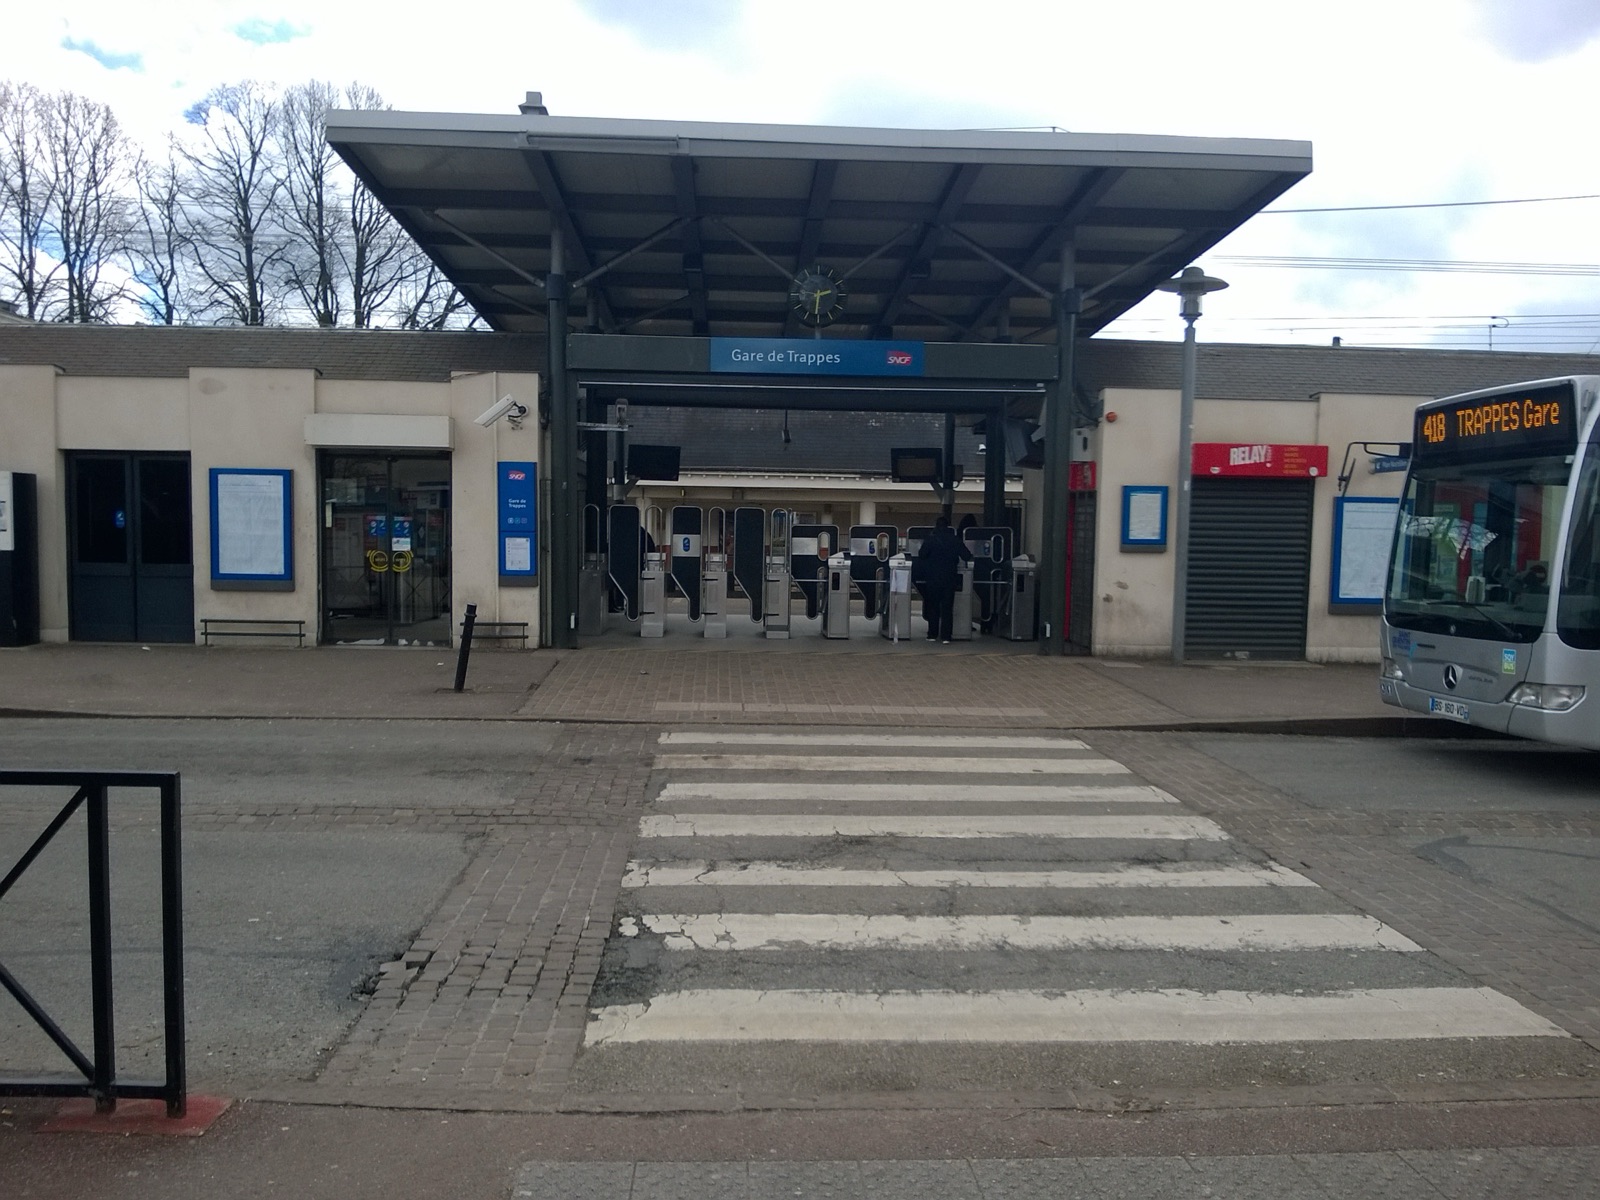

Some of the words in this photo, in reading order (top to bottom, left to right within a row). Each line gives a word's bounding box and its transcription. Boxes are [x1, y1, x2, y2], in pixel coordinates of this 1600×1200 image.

[731, 348, 764, 362] Gare
[767, 350, 784, 362] de
[787, 350, 841, 366] Trappes
[887, 355, 912, 365] SNCF
[1423, 412, 1446, 443] 418
[1456, 401, 1520, 437] TRAPPES
[1523, 399, 1560, 429] Gare
[1229, 444, 1267, 466] RELAY
